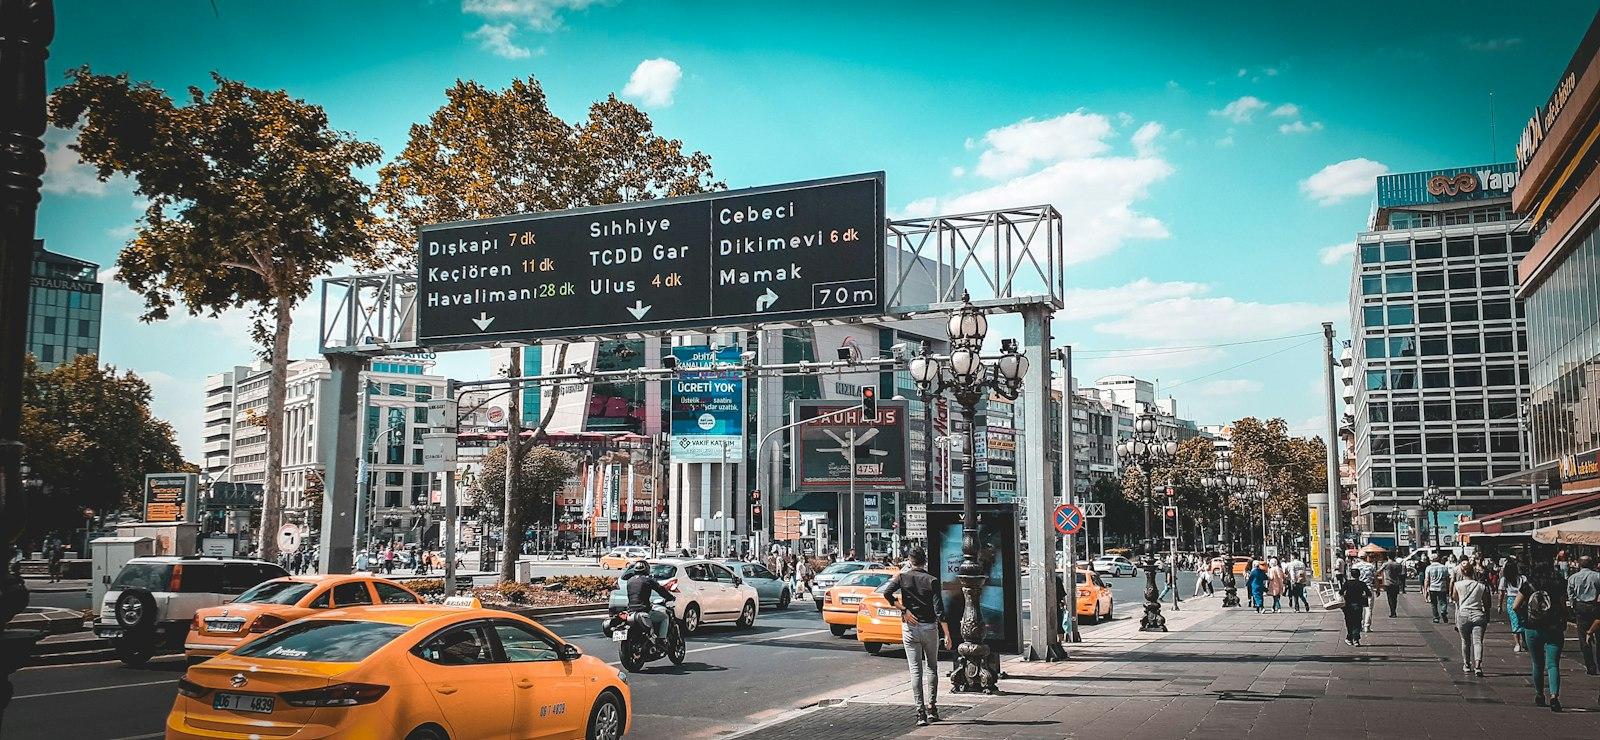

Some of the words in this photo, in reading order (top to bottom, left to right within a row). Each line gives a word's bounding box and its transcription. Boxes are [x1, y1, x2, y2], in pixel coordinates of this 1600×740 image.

[719, 202, 794, 225] Cebeci
[590, 218, 671, 238] Sıhhiye
[429, 238, 498, 256] Dışkapı
[509, 233, 517, 247] 7
[519, 231, 536, 245] dk
[720, 230, 823, 256] Dikimevi
[829, 229, 839, 243] 6
[842, 228, 859, 242] dk
[589, 246, 643, 267] TCDD
[653, 244, 689, 261] Gar
[428, 264, 512, 283] Keçiören
[522, 259, 535, 273] 11
[539, 257, 555, 271] dk
[719, 263, 802, 286] Mamak
[427, 288, 537, 307] Havalimanı
[539, 283, 556, 298] 28
[557, 280, 576, 296] dk
[590, 278, 636, 295] Ulus
[651, 273, 661, 288] 4
[665, 272, 682, 287] dk
[677, 380, 712, 393] ÜCRETİ
[835, 381, 863, 398] KIZILA
[220, 694, 231, 708] 06
[250, 697, 273, 711] 4839
